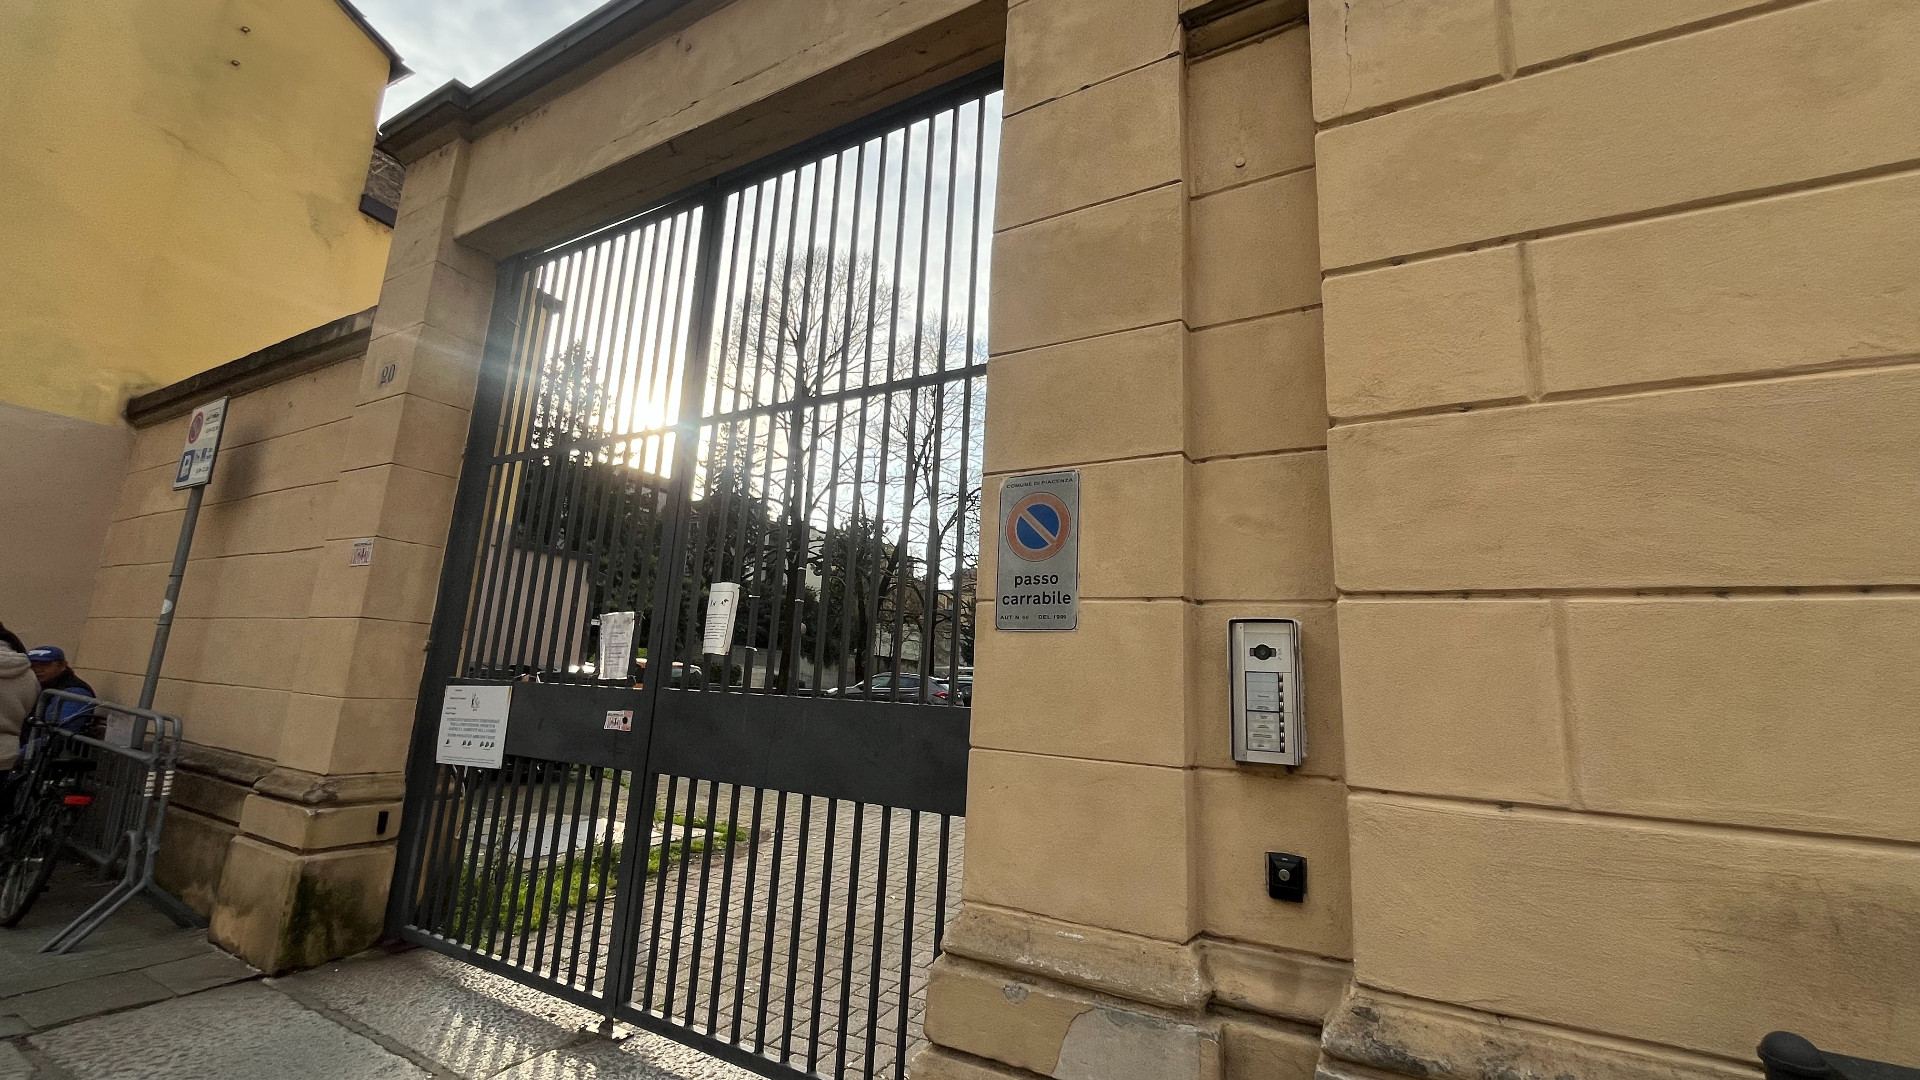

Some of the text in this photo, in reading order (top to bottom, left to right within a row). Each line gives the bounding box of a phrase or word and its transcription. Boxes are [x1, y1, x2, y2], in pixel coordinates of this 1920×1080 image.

[381, 364, 395, 384] 20
[1006, 481, 1032, 489] COMUNE
[1014, 574, 1059, 588] passo
[1002, 591, 1071, 605] carrabile
